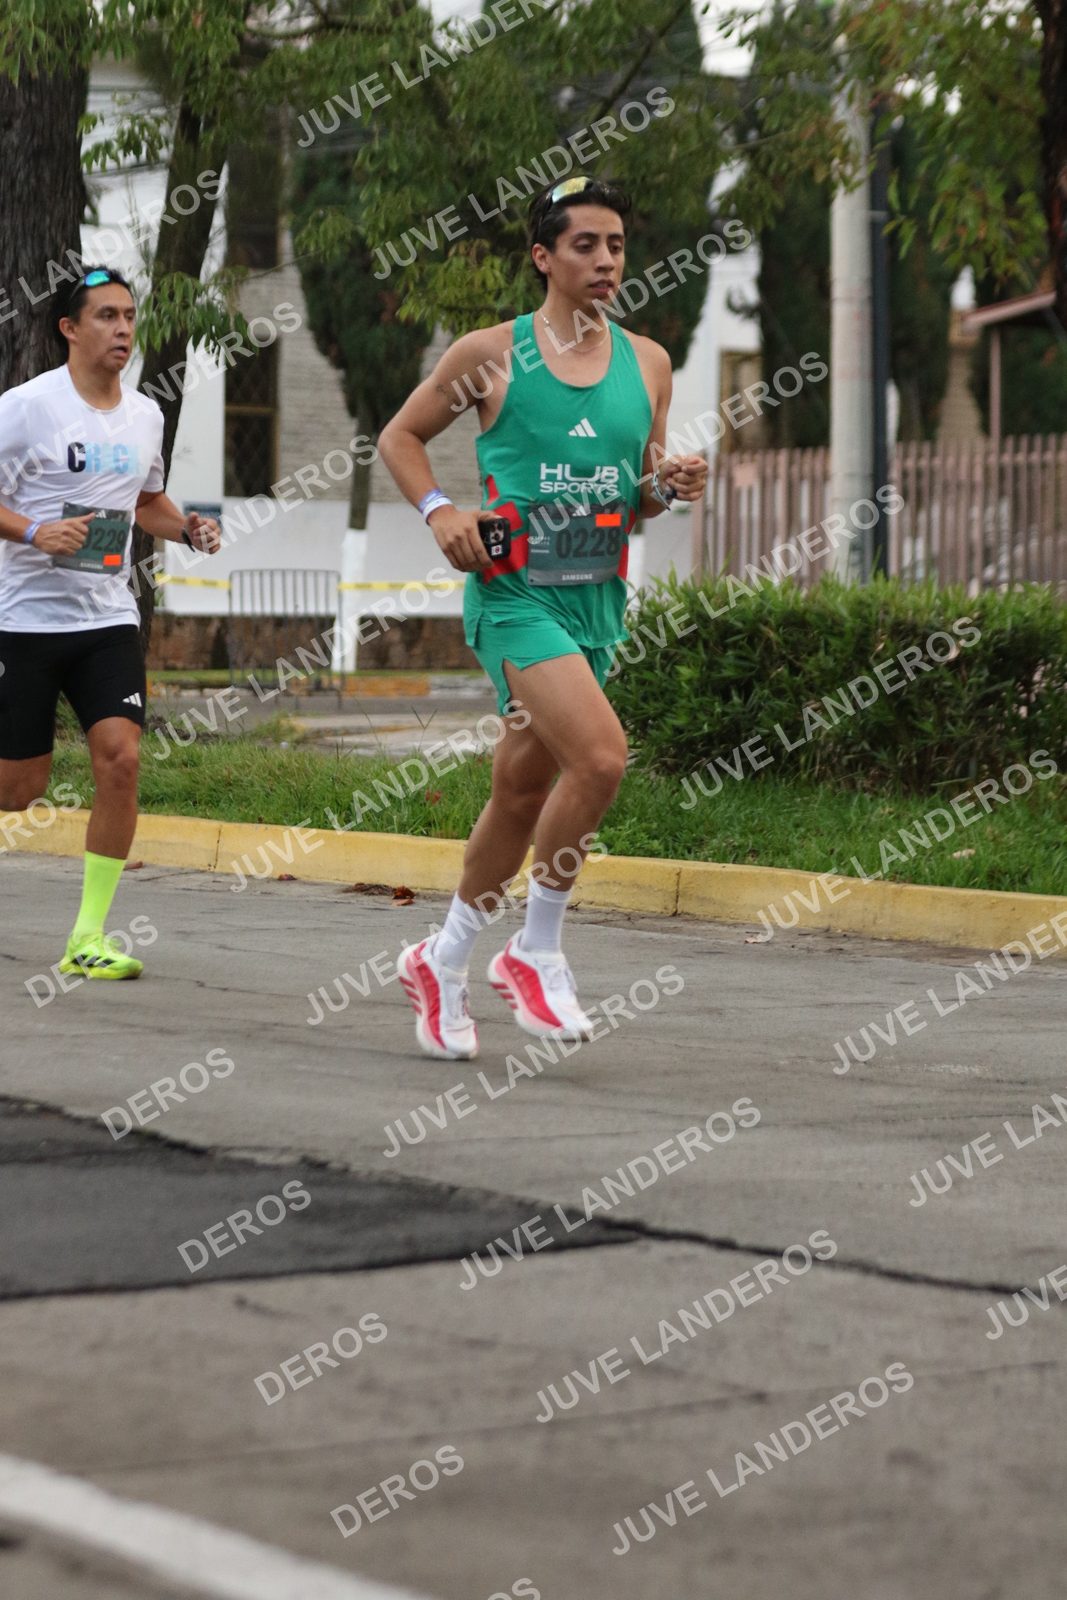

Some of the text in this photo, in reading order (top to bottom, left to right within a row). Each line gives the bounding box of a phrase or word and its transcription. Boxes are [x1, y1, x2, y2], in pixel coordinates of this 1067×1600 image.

[540, 463, 619, 482] HUB
[540, 482, 618, 496] SPORTS
[555, 527, 621, 559] 0228
